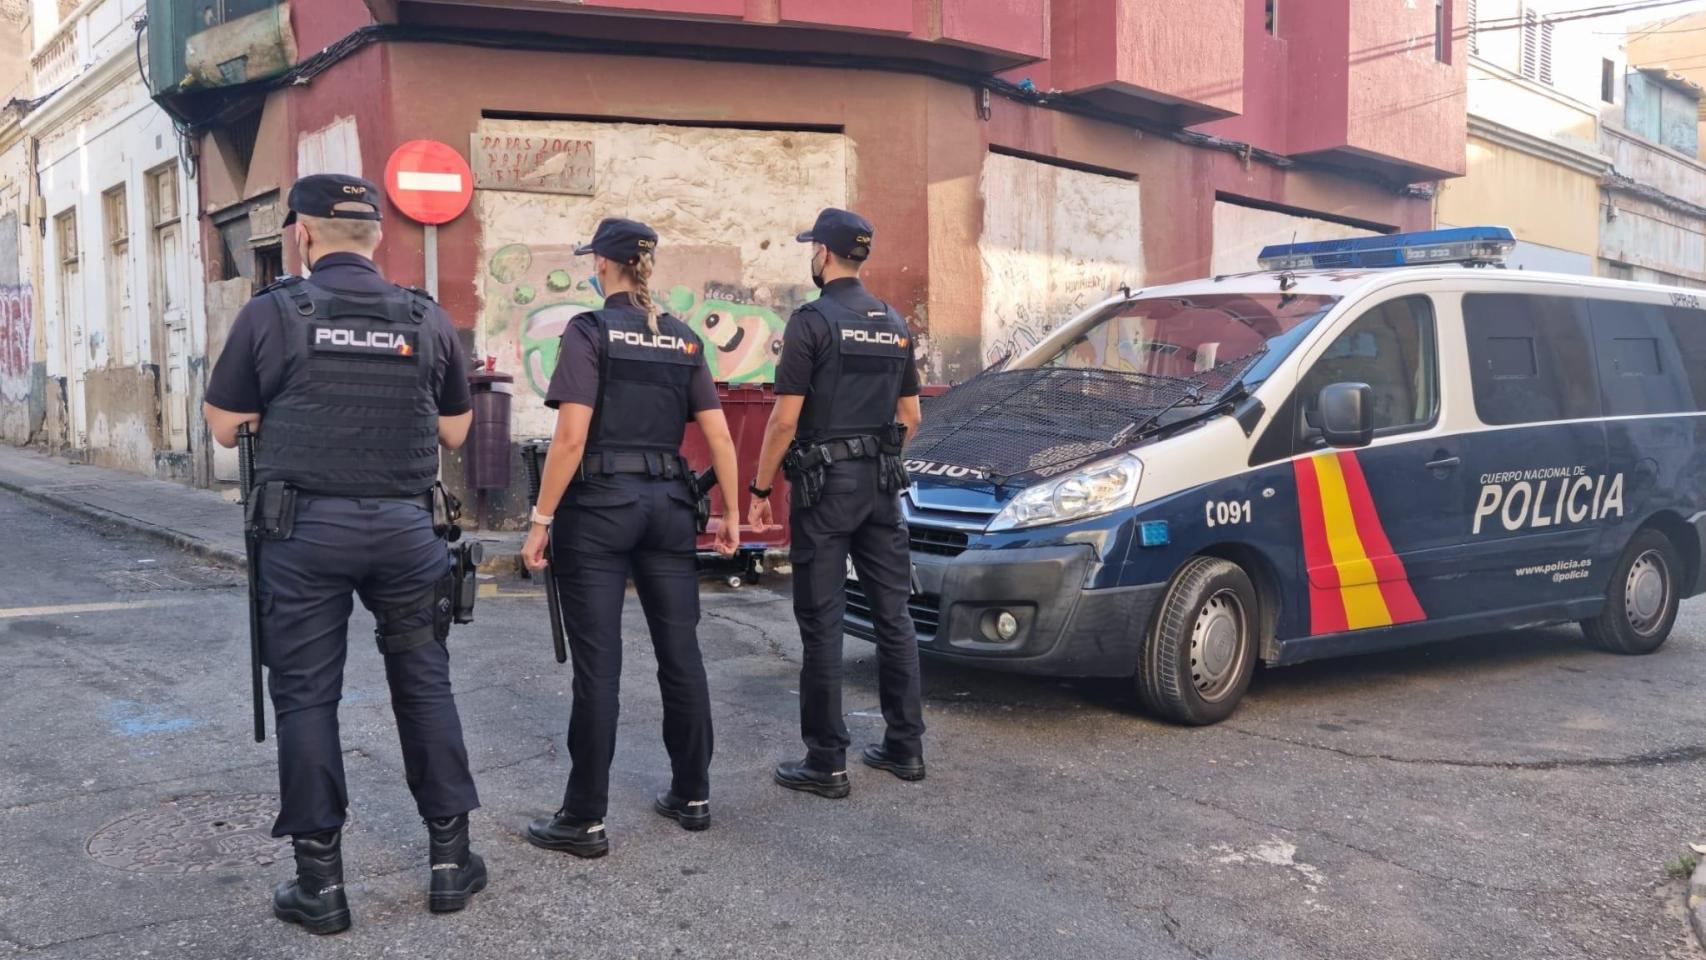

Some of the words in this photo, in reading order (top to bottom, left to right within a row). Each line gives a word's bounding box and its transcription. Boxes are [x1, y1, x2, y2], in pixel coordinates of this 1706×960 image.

[343, 185, 367, 194] CNP
[315, 328, 407, 349] POLICIA
[608, 329, 688, 351] POLICIA
[841, 329, 901, 345] POLICIA
[1480, 471, 1522, 484] CUERPO
[1524, 467, 1571, 480] NACIONAL
[1573, 465, 1586, 476] DE
[1472, 473, 1624, 535] POLICIA
[1515, 558, 1592, 576] www.policia.es
[1552, 569, 1589, 583] @policia
